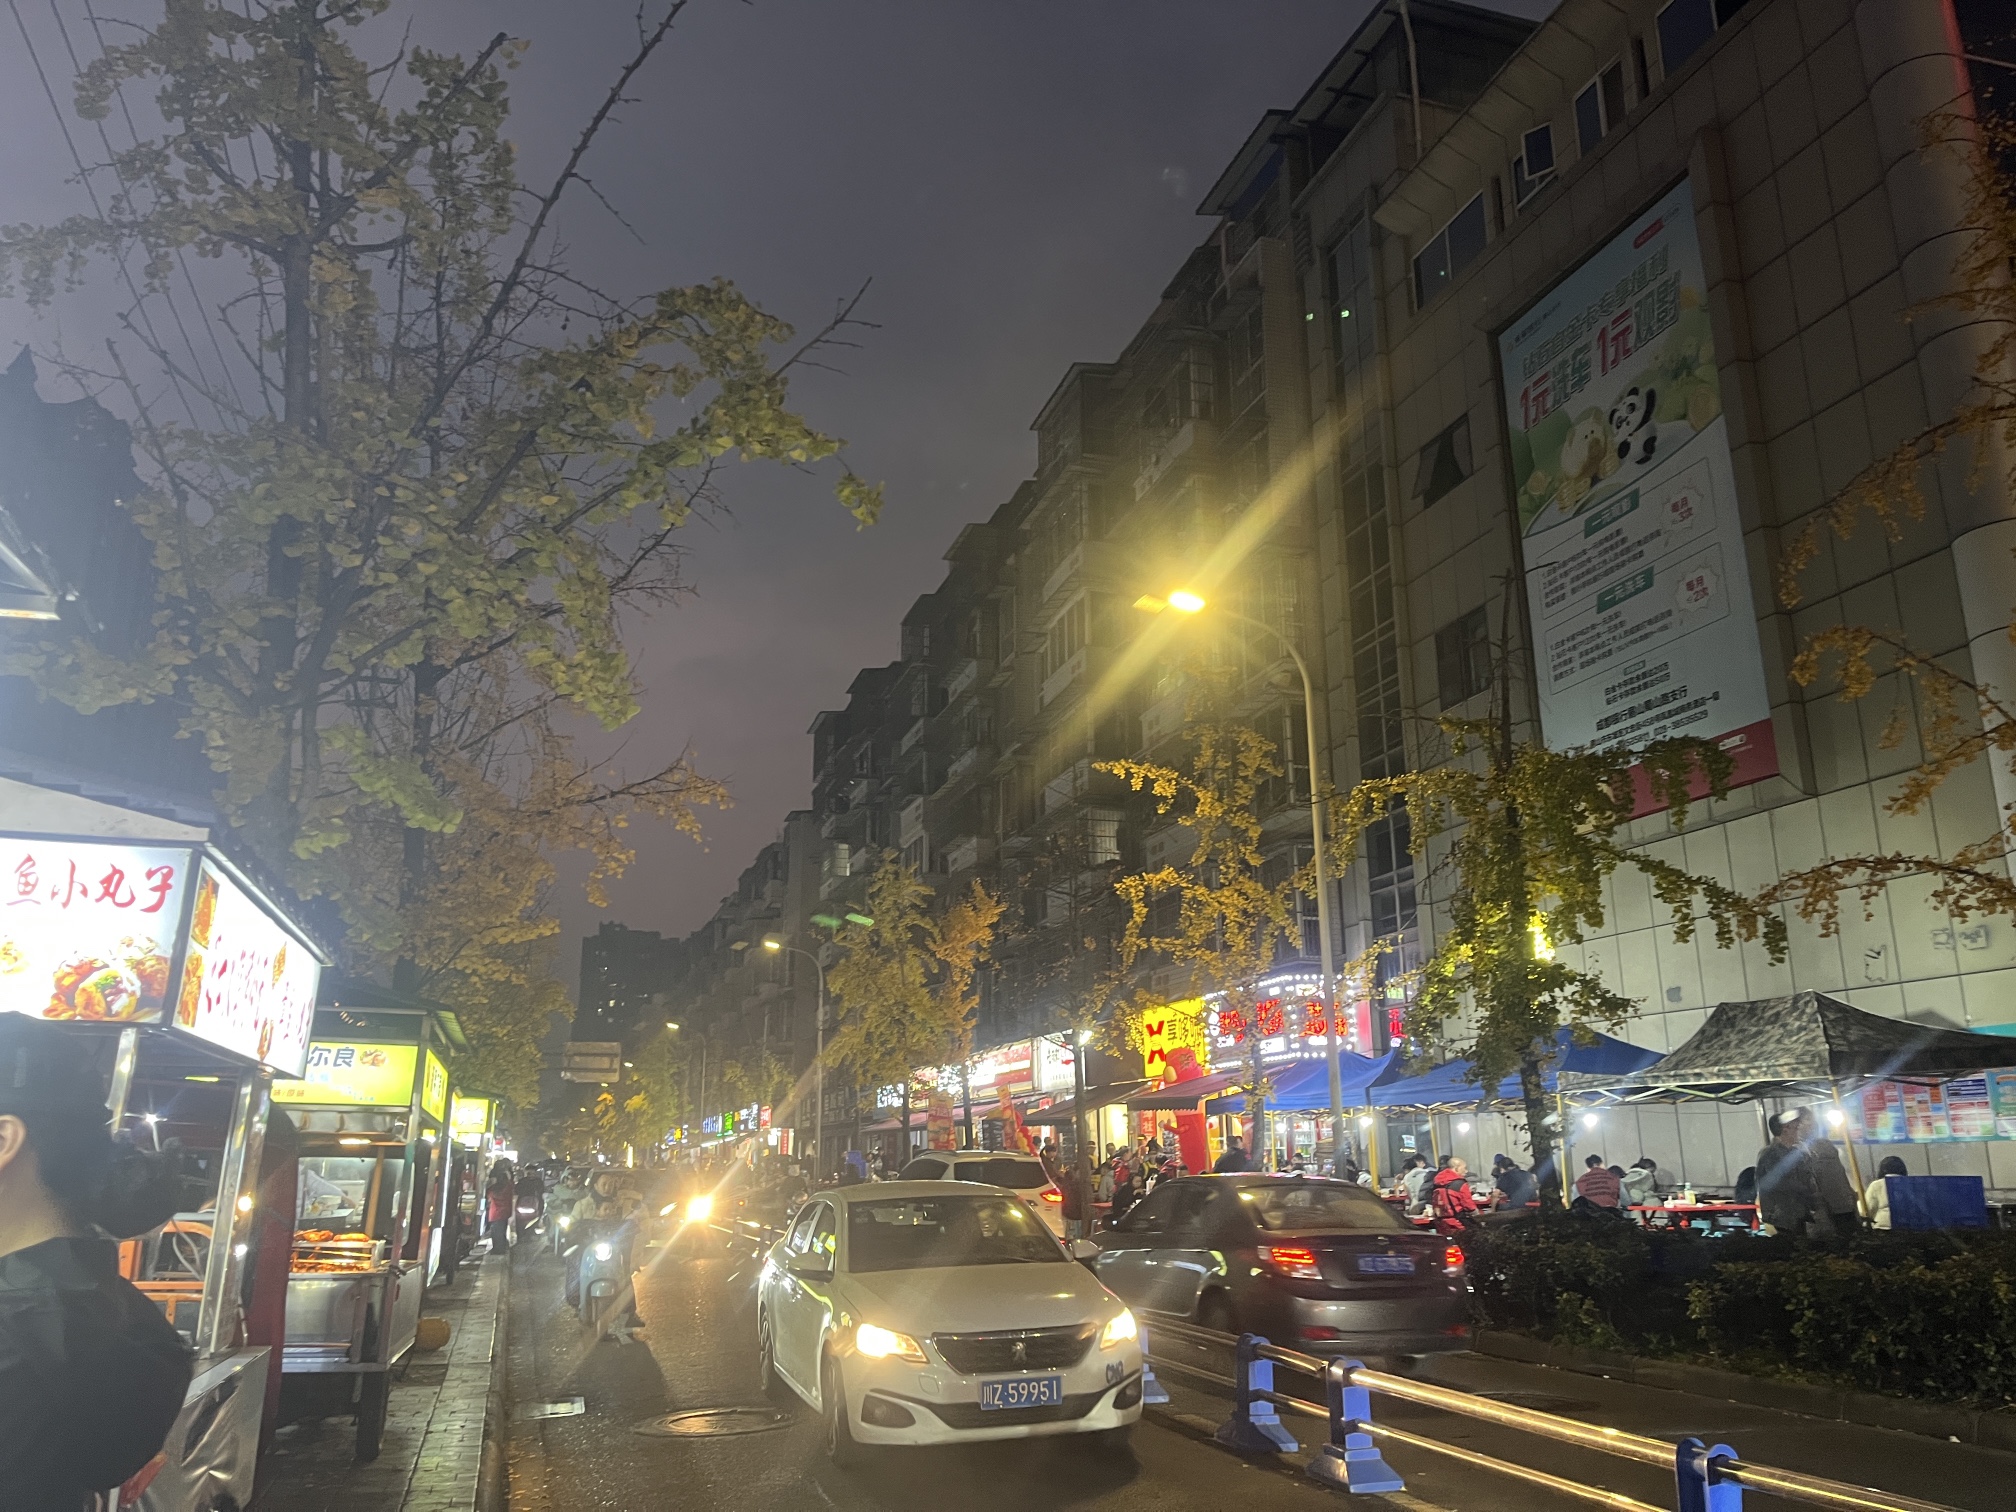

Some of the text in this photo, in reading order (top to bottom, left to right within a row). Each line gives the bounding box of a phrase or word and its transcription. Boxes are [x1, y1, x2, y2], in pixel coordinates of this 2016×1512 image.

[1522, 243, 1669, 379] 钻石白金卡专享福利
[1520, 340, 1592, 432] 1元洗车
[1596, 268, 1682, 376] 1元观影
[1591, 498, 1633, 527] 一元观影
[1670, 496, 1689, 514] 每月
[1603, 573, 1646, 602] 一元洗车
[1685, 575, 1705, 592] 每月
[6, 852, 175, 914] 鱼小丸子
[306, 1046, 356, 1068] 尔良
[983, 1379, 1058, 1405] 川Z·59951
